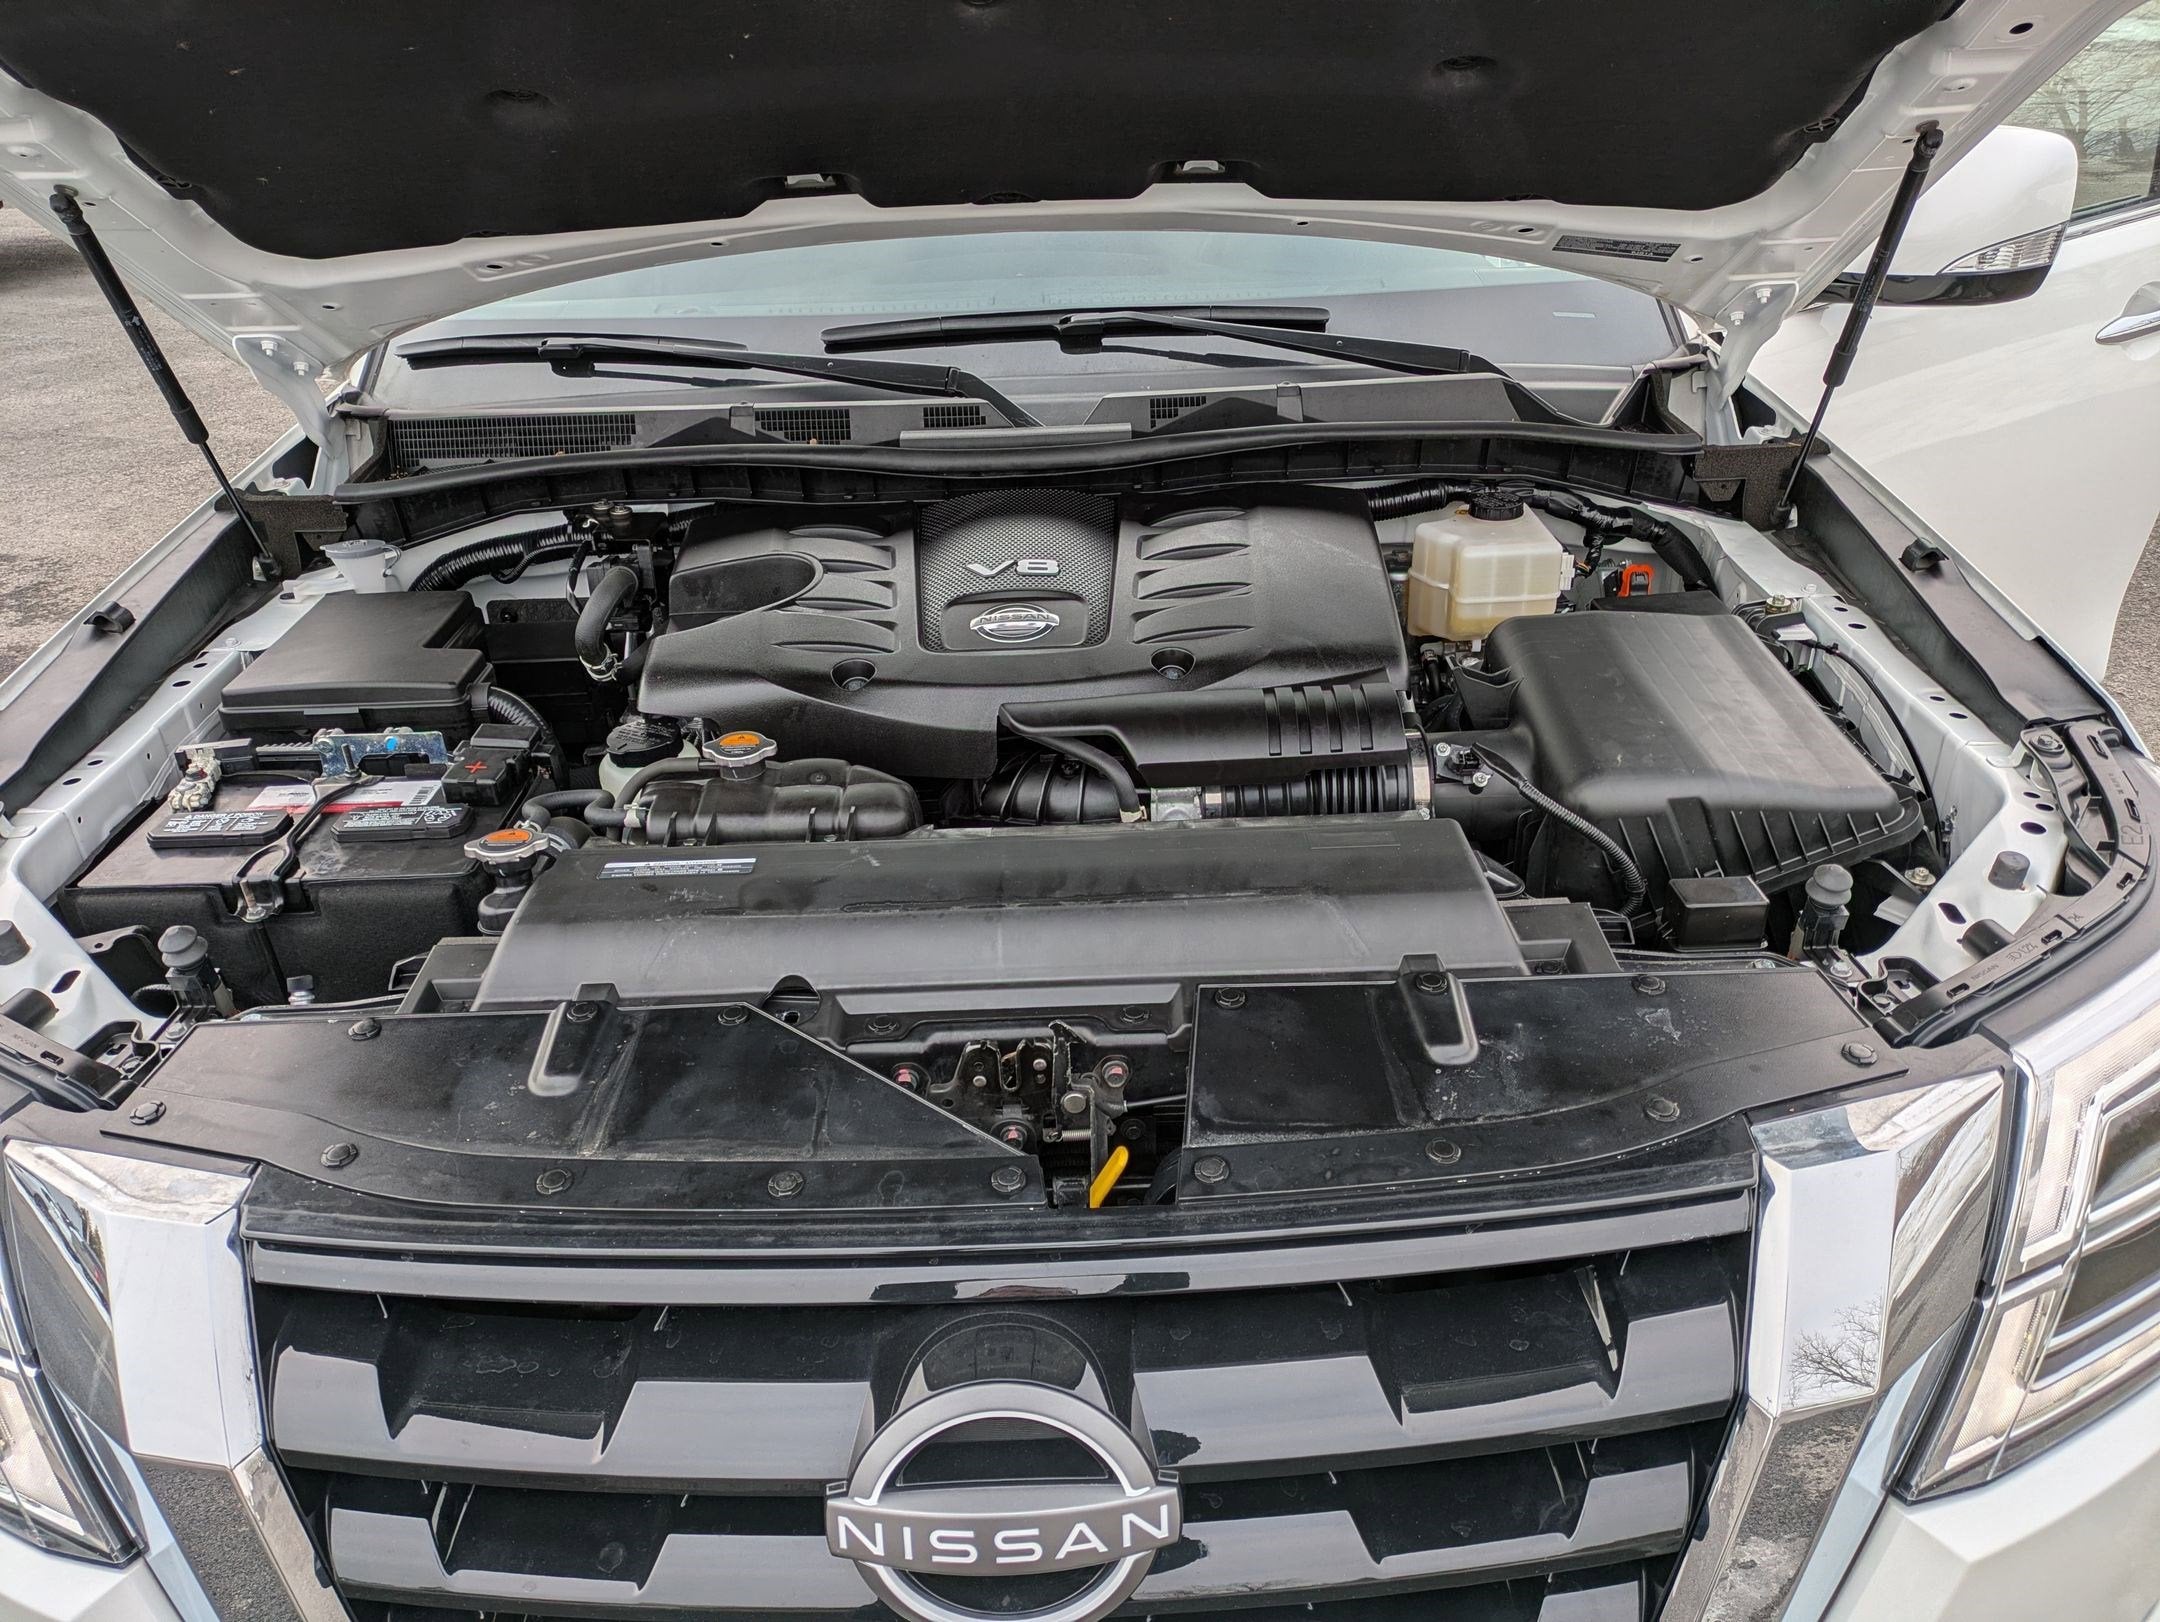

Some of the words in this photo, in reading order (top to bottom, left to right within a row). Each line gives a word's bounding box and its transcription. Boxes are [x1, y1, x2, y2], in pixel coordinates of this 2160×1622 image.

[965, 559, 1061, 579] V8
[979, 613, 1050, 624] NISSAN
[837, 1504, 1170, 1564] NISSAN
